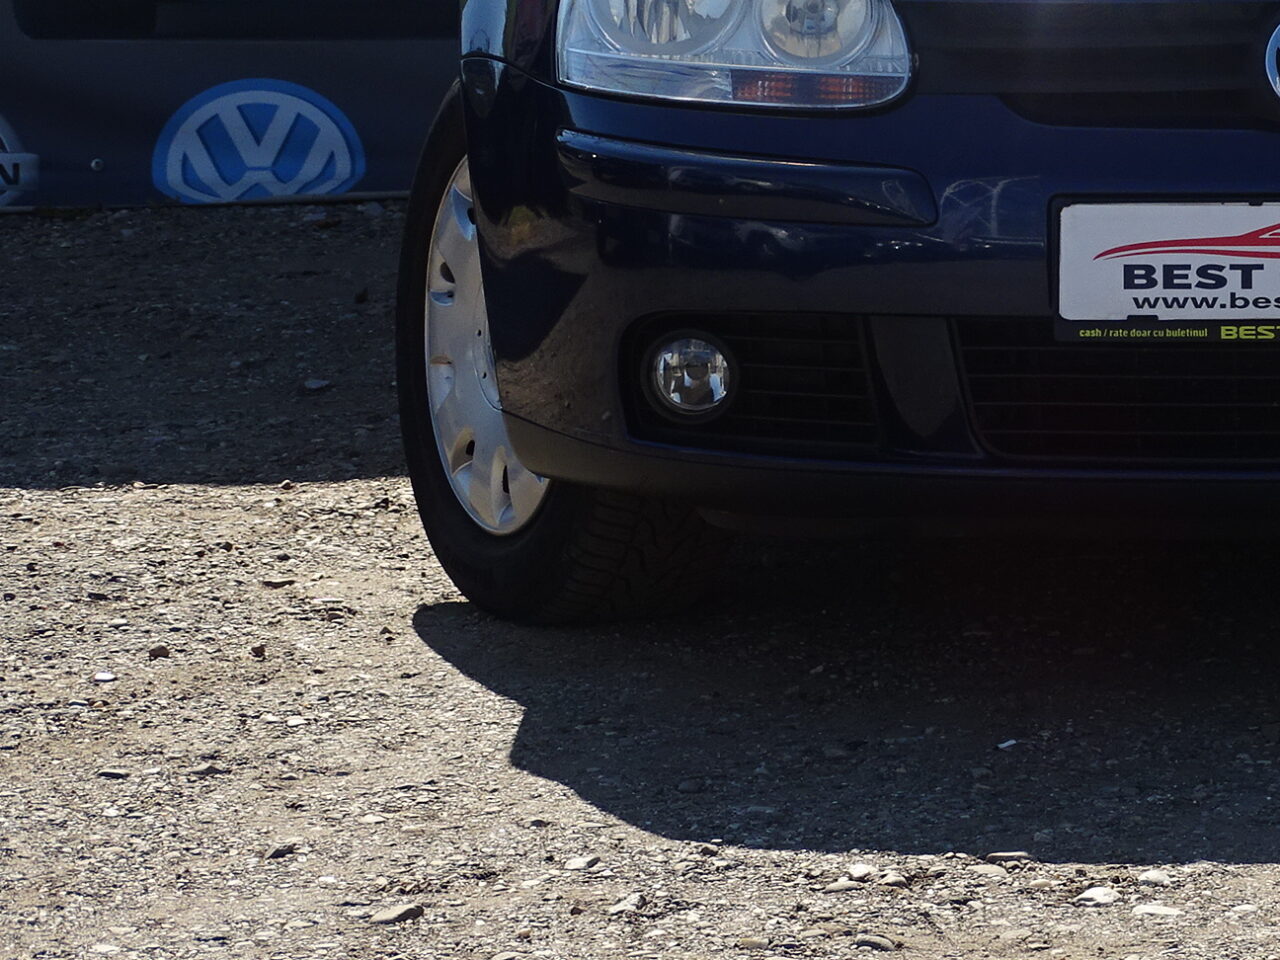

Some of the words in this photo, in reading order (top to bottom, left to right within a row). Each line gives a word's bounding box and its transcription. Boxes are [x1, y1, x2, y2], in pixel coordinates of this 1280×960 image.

[1123, 263, 1264, 290] BEST
[1079, 328, 1101, 337] cash
[1109, 329, 1128, 337] rate
[1130, 328, 1151, 337] doar
